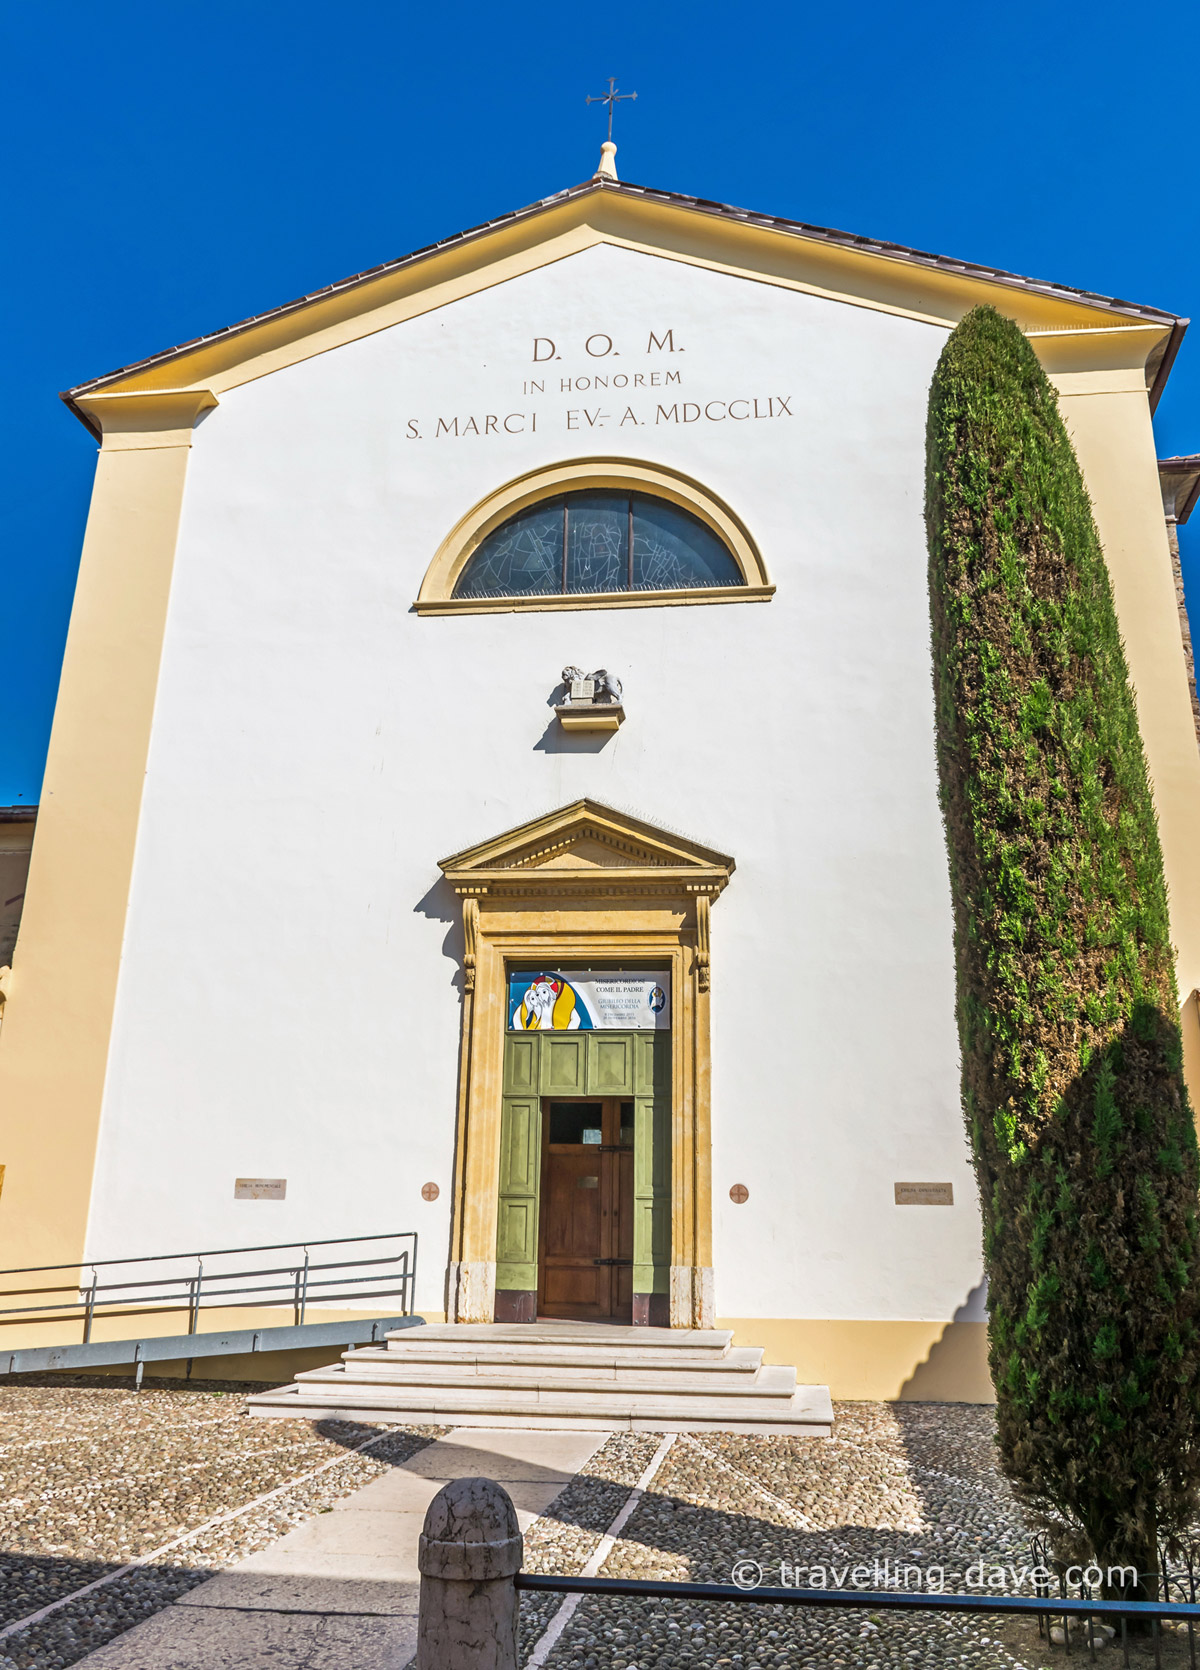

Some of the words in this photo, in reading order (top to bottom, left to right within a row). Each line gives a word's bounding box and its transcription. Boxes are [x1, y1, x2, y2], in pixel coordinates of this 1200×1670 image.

[532, 337, 562, 362] D.
[585, 333, 621, 358] O.
[646, 329, 686, 354] M.
[523, 379, 545, 395] IN
[559, 370, 682, 393] HONOREM
[406, 419, 423, 440] S.
[435, 412, 537, 438] MARCI
[620, 406, 645, 427] A.
[655, 396, 794, 426] MDCCLIX
